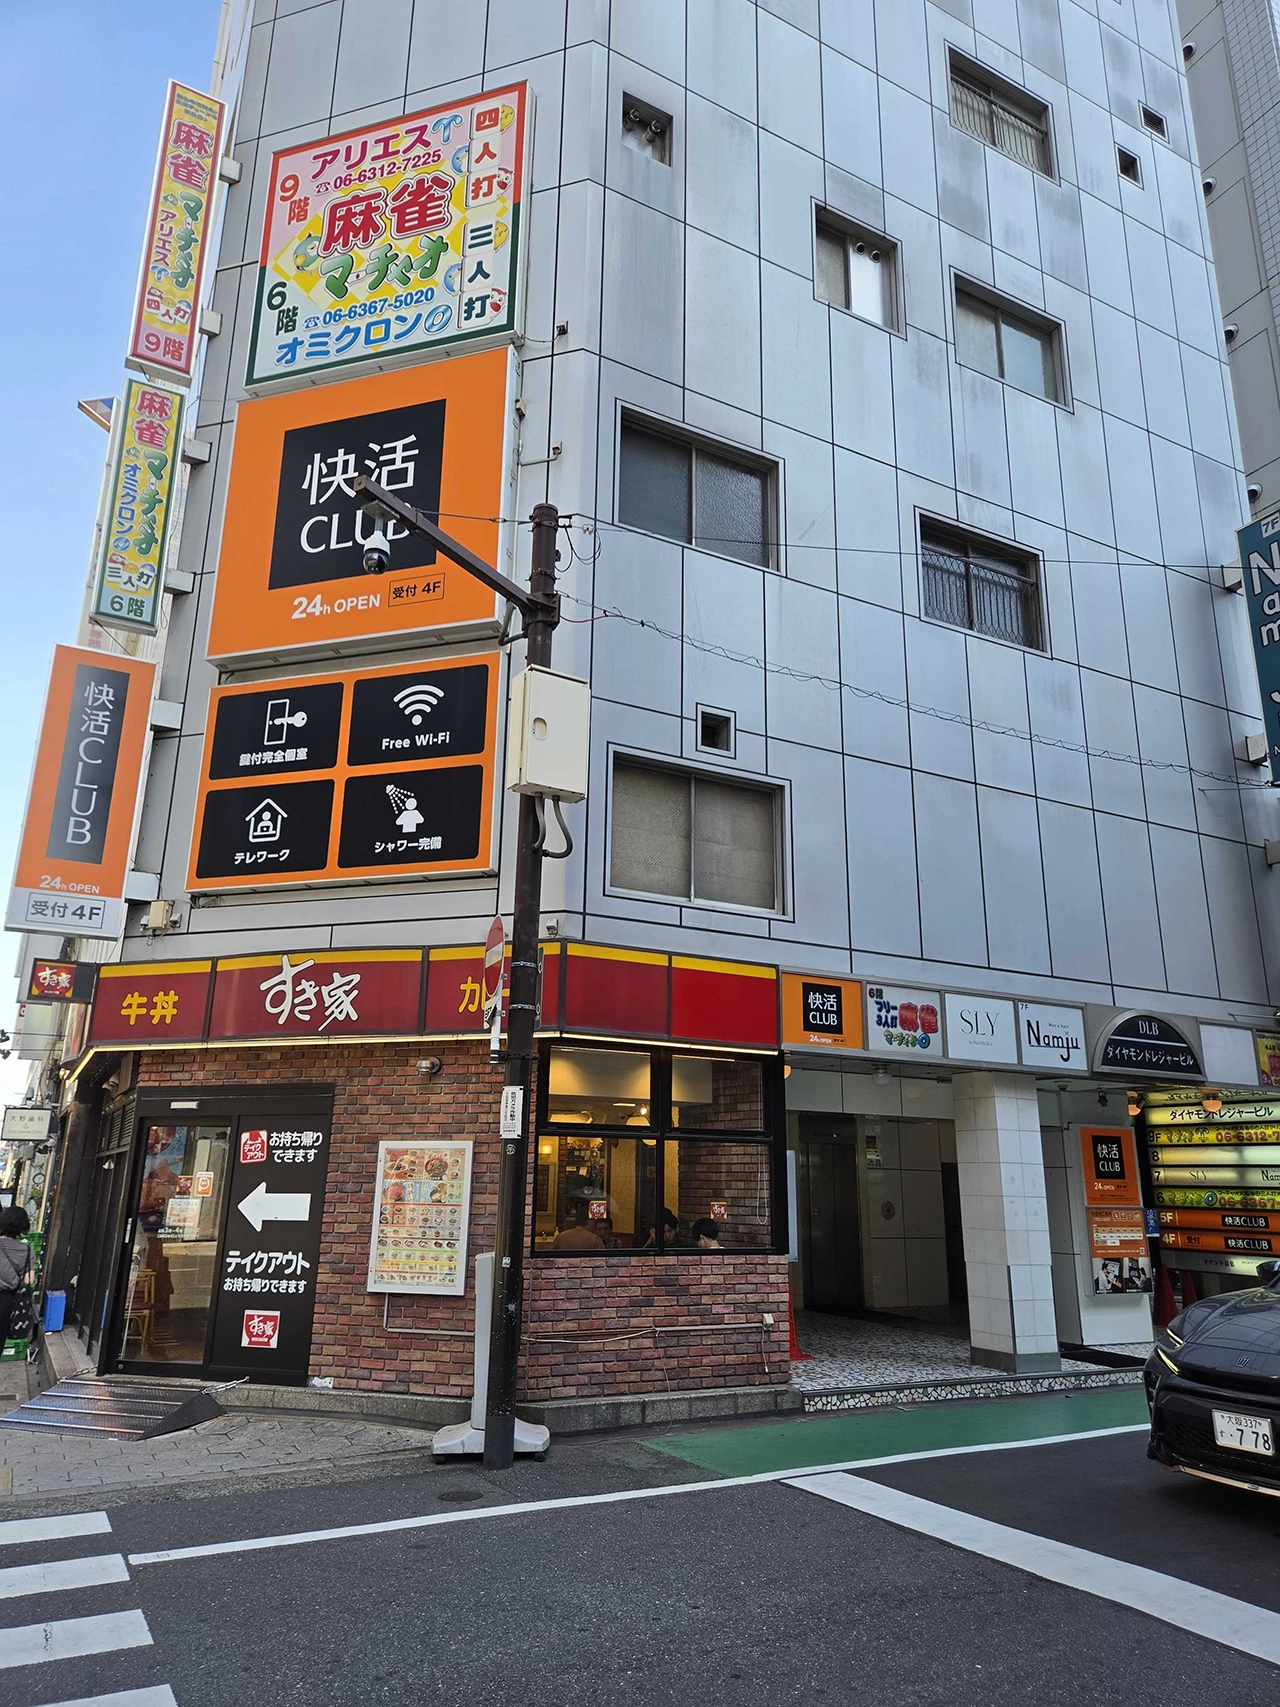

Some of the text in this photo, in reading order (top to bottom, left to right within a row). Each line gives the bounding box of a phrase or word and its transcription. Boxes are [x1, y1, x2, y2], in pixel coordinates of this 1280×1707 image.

[169, 119, 214, 192] 麻雀
[310, 122, 431, 182] アリエス
[471, 105, 500, 201] 四人打
[333, 147, 442, 190] 06-6312-7225
[278, 174, 309, 226] 9階
[321, 171, 456, 256] 麻雀
[152, 208, 177, 267] アリエス
[462, 221, 495, 321] 三人打
[266, 280, 299, 337] 6階
[322, 287, 435, 326] 06-6367-5020
[144, 332, 185, 362] 9階
[274, 311, 424, 367] オミクロン
[131, 387, 174, 449] 麻雀
[301, 434, 419, 506] 快活
[115, 462, 142, 537] オミクロン
[1263, 516, 1279, 534] 7F
[392, 581, 442, 600] 受付 4F
[109, 594, 146, 618] 6階
[291, 594, 381, 620] 24h OPEN
[381, 731, 450, 750] Free Wi-Fi
[65, 681, 116, 846] 快活CLUB
[238, 747, 309, 767] 鍵付完全個室
[374, 836, 443, 853] シャワー完備
[233, 849, 291, 866] テレワーク
[68, 881, 101, 895] OPEN
[30, 900, 102, 921] 受付 4F
[37, 966, 72, 990] すき家
[259, 953, 362, 1033] すき家
[807, 991, 838, 1011] 快活
[868, 987, 884, 1000] 6階
[120, 988, 179, 1026] 牛丼
[874, 1000, 898, 1014] フリー
[809, 1011, 838, 1026] CLUB
[960, 1008, 1000, 1037] SLY
[1138, 1020, 1159, 1036] DLB
[1026, 1019, 1079, 1063] Namju
[1106, 1045, 1195, 1067] ダイヤモンドレジャービル
[269, 1130, 324, 1148] お持ち帰り
[1148, 1130, 1161, 1143] 9F
[243, 1144, 262, 1153] テイク
[246, 1151, 265, 1160] アウト
[271, 1148, 318, 1164] できます
[1096, 1143, 1120, 1159] 快活
[1151, 1150, 1160, 1162] 8
[1099, 1160, 1121, 1172] CLUB
[1189, 1170, 1208, 1181] SLY
[1154, 1171, 1161, 1184] 7
[1157, 1192, 1165, 1204] 6
[1160, 1212, 1174, 1223] 5F
[1225, 1215, 1266, 1228] 快活CLUB
[1162, 1233, 1176, 1244] 4F
[1227, 1238, 1269, 1250] 快活CLUB
[225, 1250, 311, 1276] テイクアウト
[223, 1277, 308, 1294] お持ち帰りできます
[248, 1314, 275, 1338] すき家
[1226, 1415, 1258, 1429] 大阪 337
